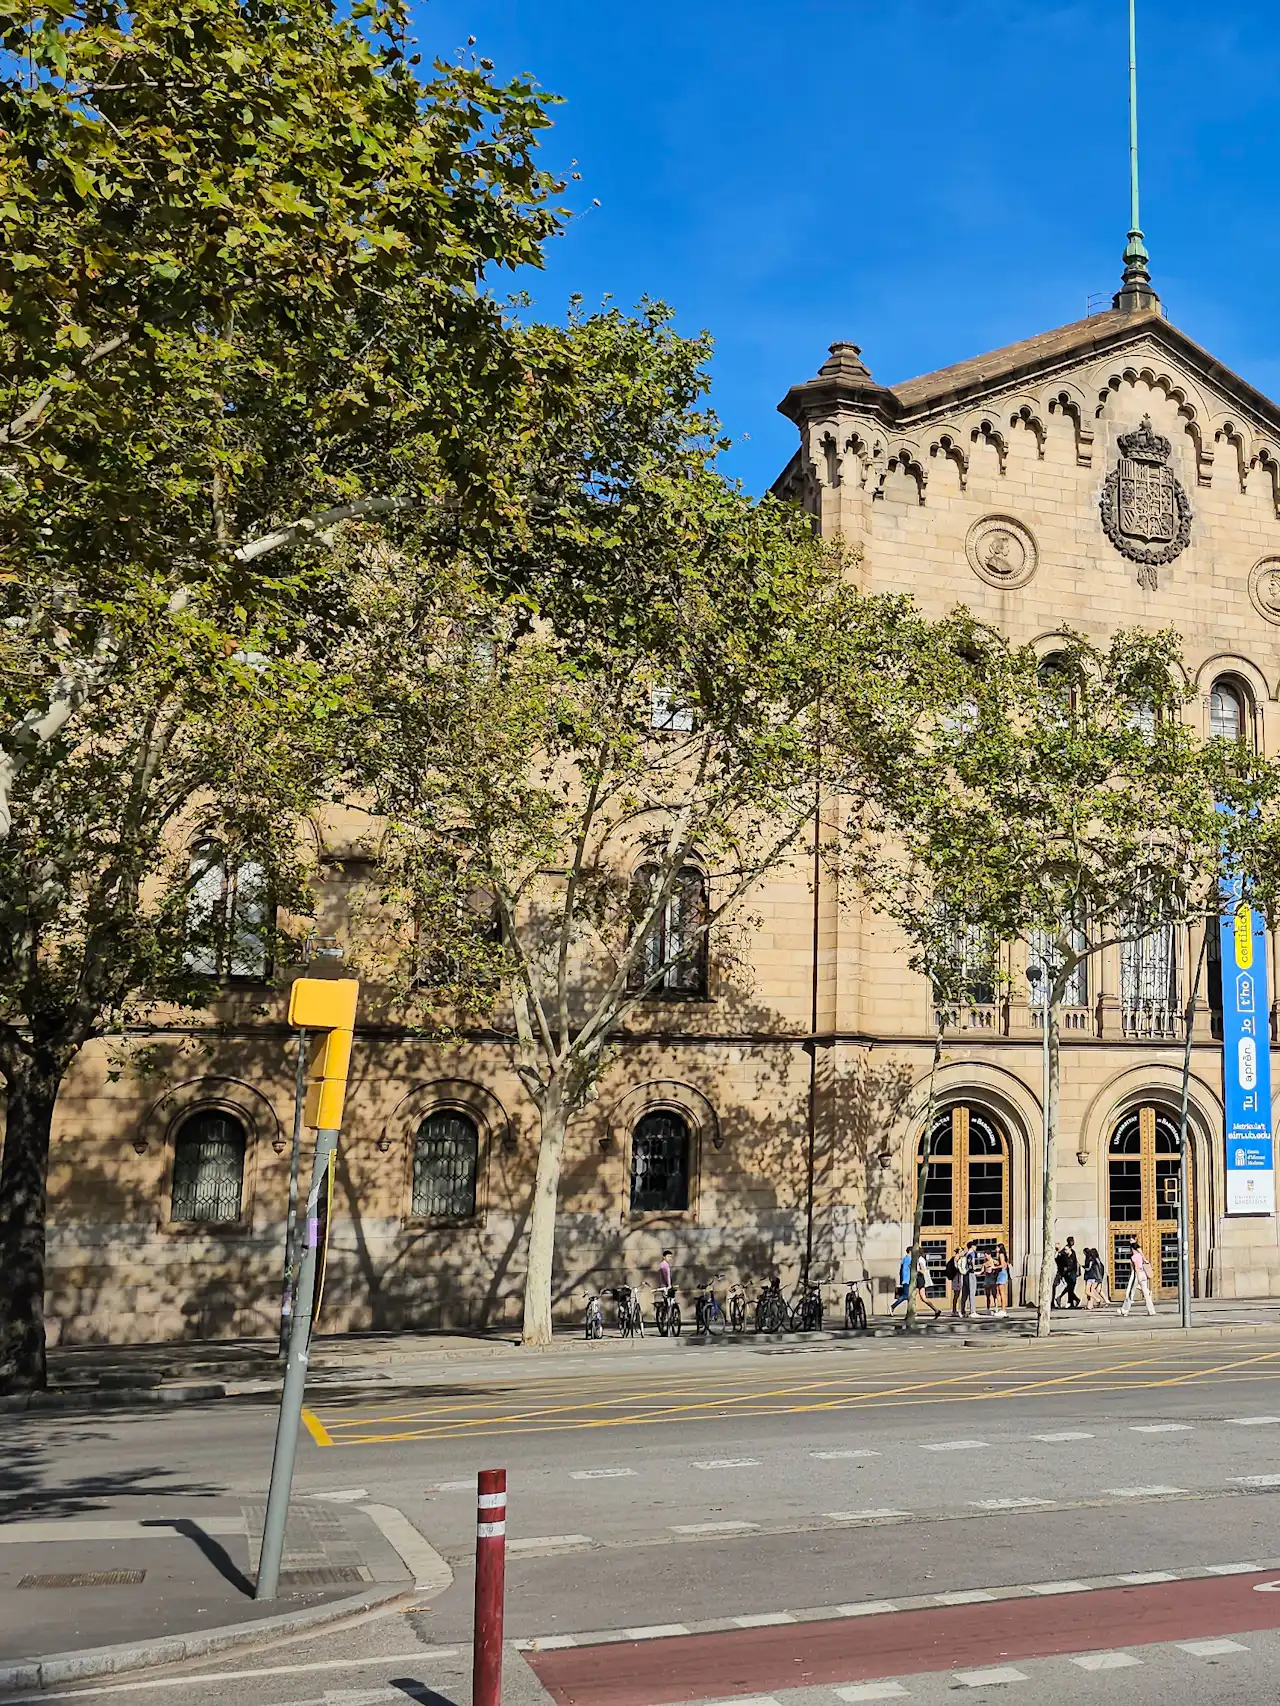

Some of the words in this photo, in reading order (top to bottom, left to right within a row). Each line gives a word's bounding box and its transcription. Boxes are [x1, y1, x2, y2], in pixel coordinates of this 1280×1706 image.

[1240, 981, 1250, 1006] t'ho
[1241, 1018, 1251, 1034] Jo
[1243, 1095, 1254, 1111] Tu
